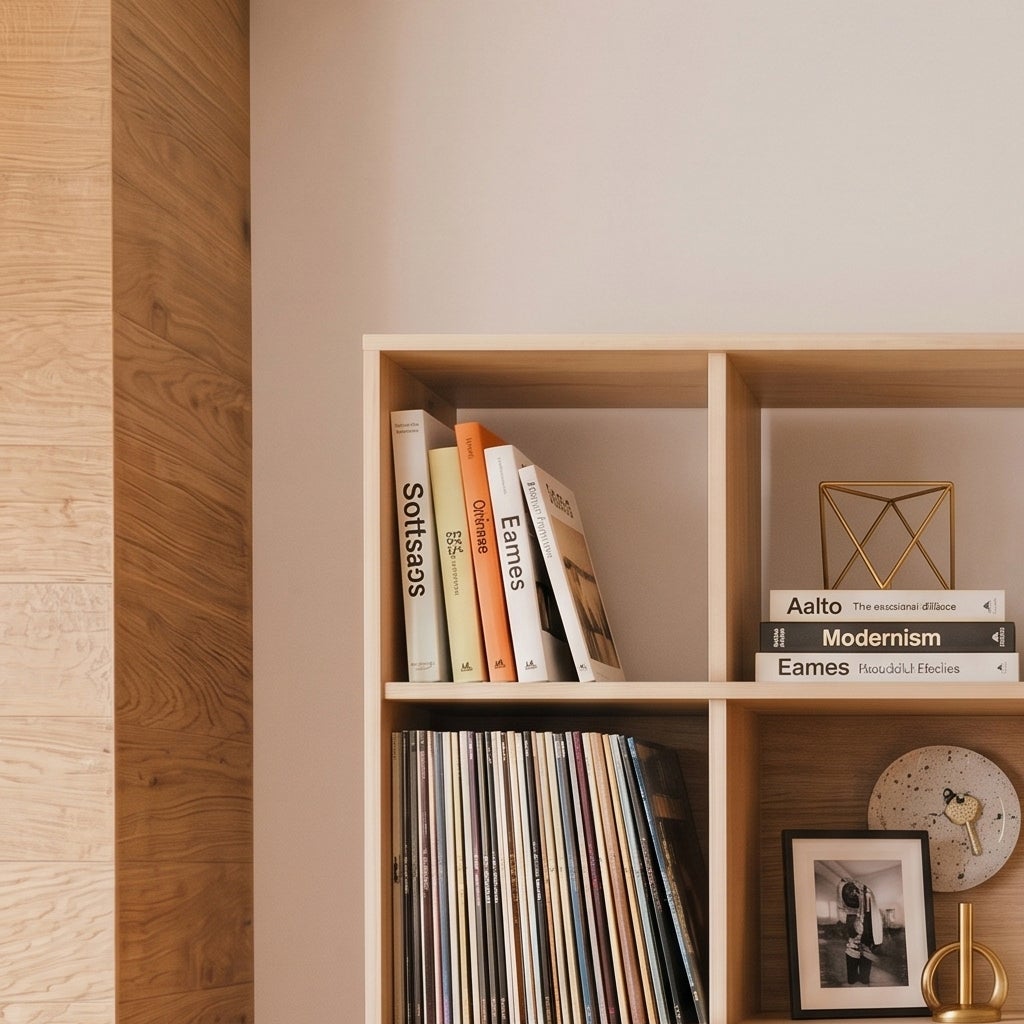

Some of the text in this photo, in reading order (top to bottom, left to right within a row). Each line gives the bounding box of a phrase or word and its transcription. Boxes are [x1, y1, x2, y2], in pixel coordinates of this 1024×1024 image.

[501, 515, 525, 591] Eames
[786, 597, 842, 615] Aalto
[853, 602, 872, 611] The
[822, 628, 941, 647] Modernism
[778, 658, 850, 676] Eames
